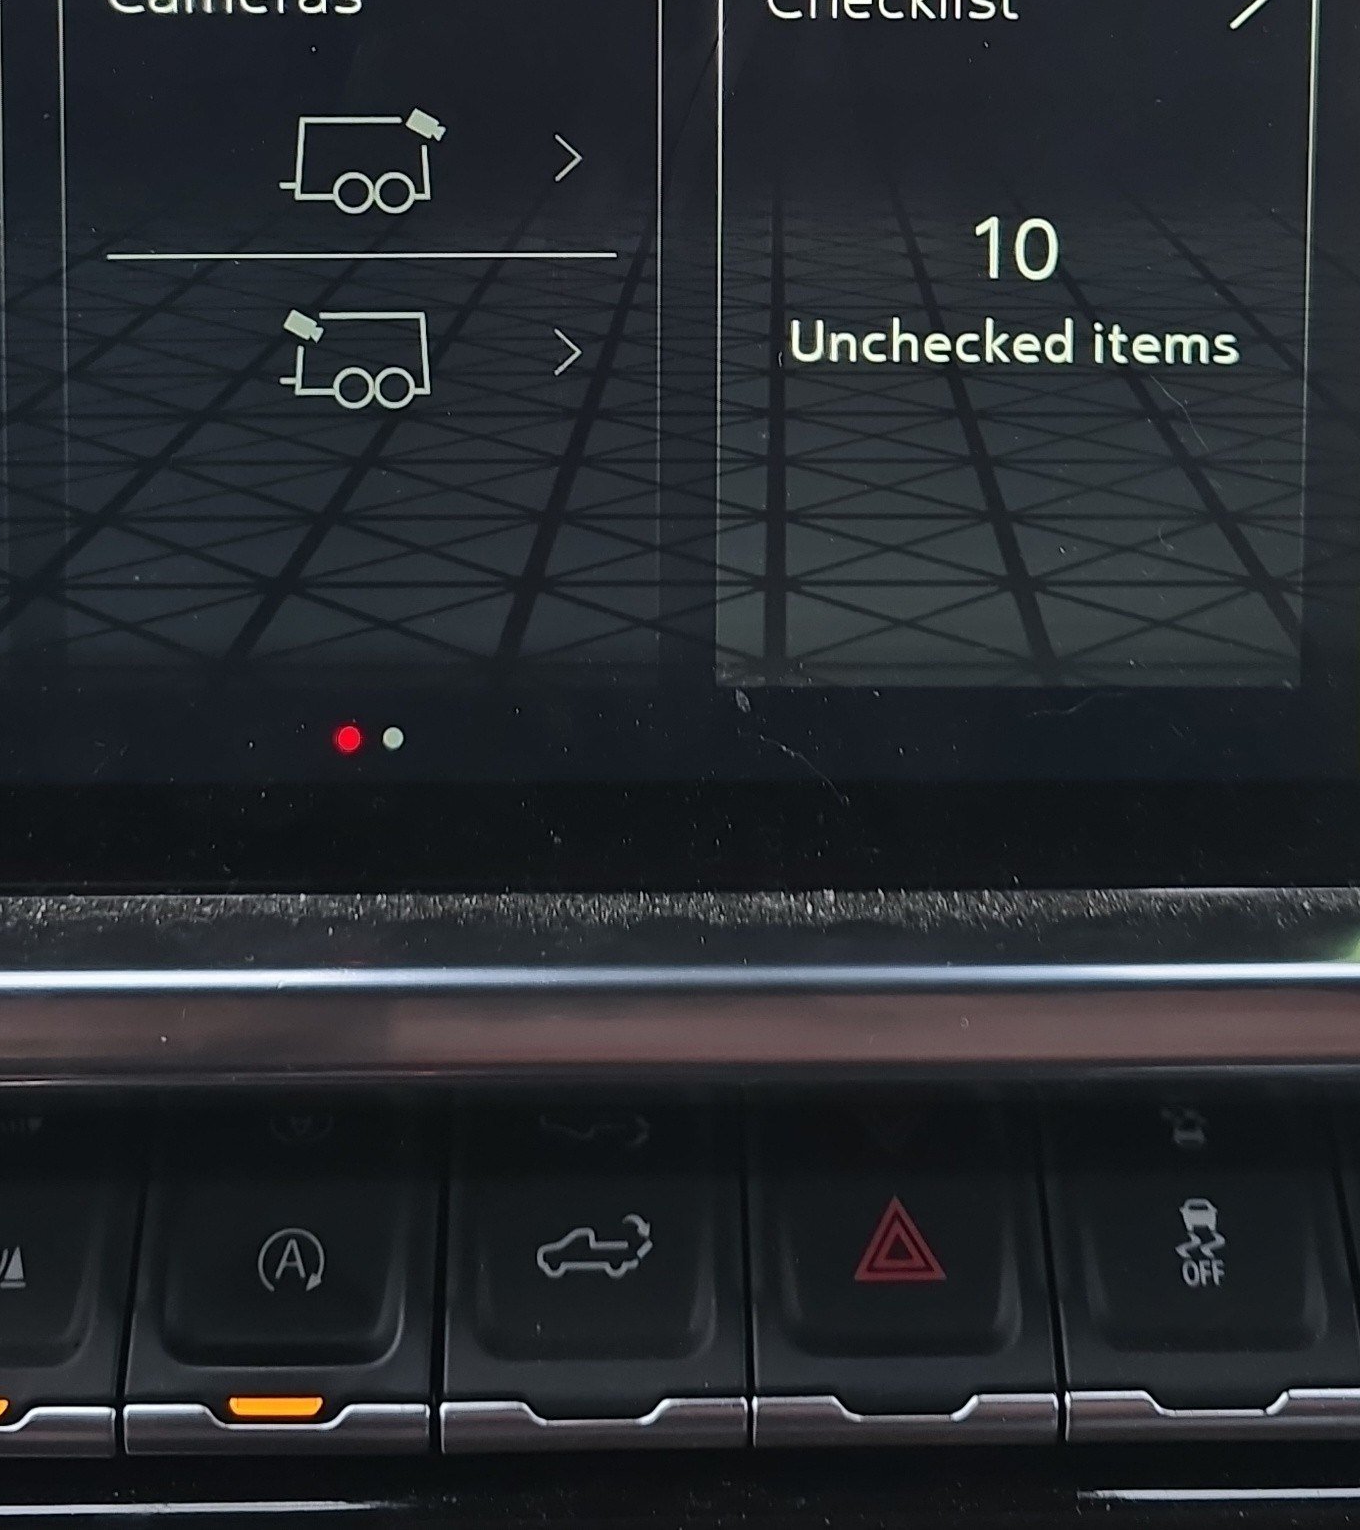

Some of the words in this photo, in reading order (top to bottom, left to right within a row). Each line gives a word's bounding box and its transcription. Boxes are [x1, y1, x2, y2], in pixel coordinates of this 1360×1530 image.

[975, 216, 1059, 281] 10
[790, 316, 1074, 364] Unchecked
[1093, 322, 1240, 365] items
[1182, 1259, 1225, 1287] OFF
